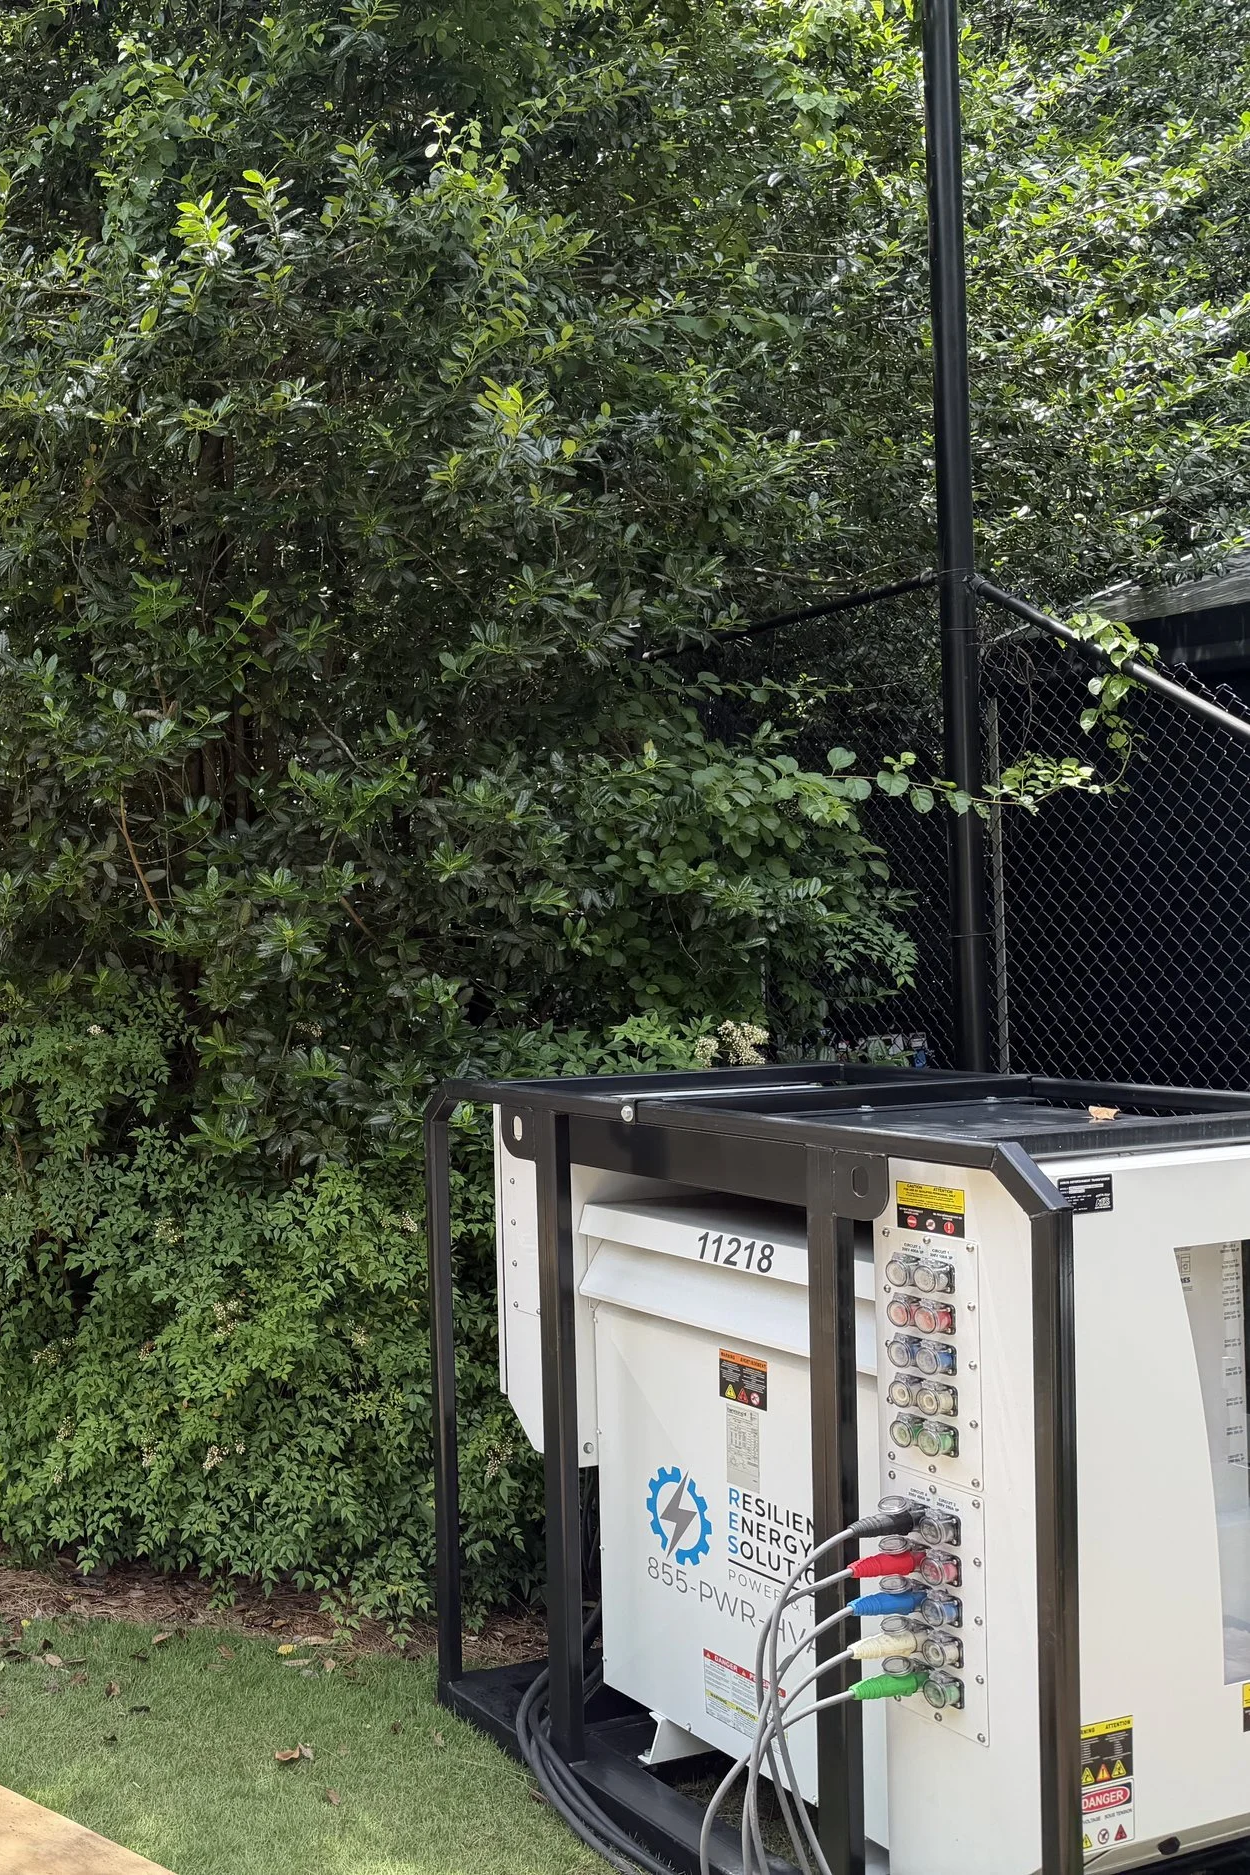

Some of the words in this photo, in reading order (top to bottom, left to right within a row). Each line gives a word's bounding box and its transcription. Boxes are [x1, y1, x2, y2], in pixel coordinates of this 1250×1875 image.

[698, 1231, 774, 1273] 11218
[729, 1487, 815, 1536] RESILIEN
[729, 1511, 813, 1558] ENERGY
[714, 1655, 738, 1672] DANGER
[1105, 1720, 1131, 1729] ATTENTION
[1082, 1790, 1124, 1810] DANGER
